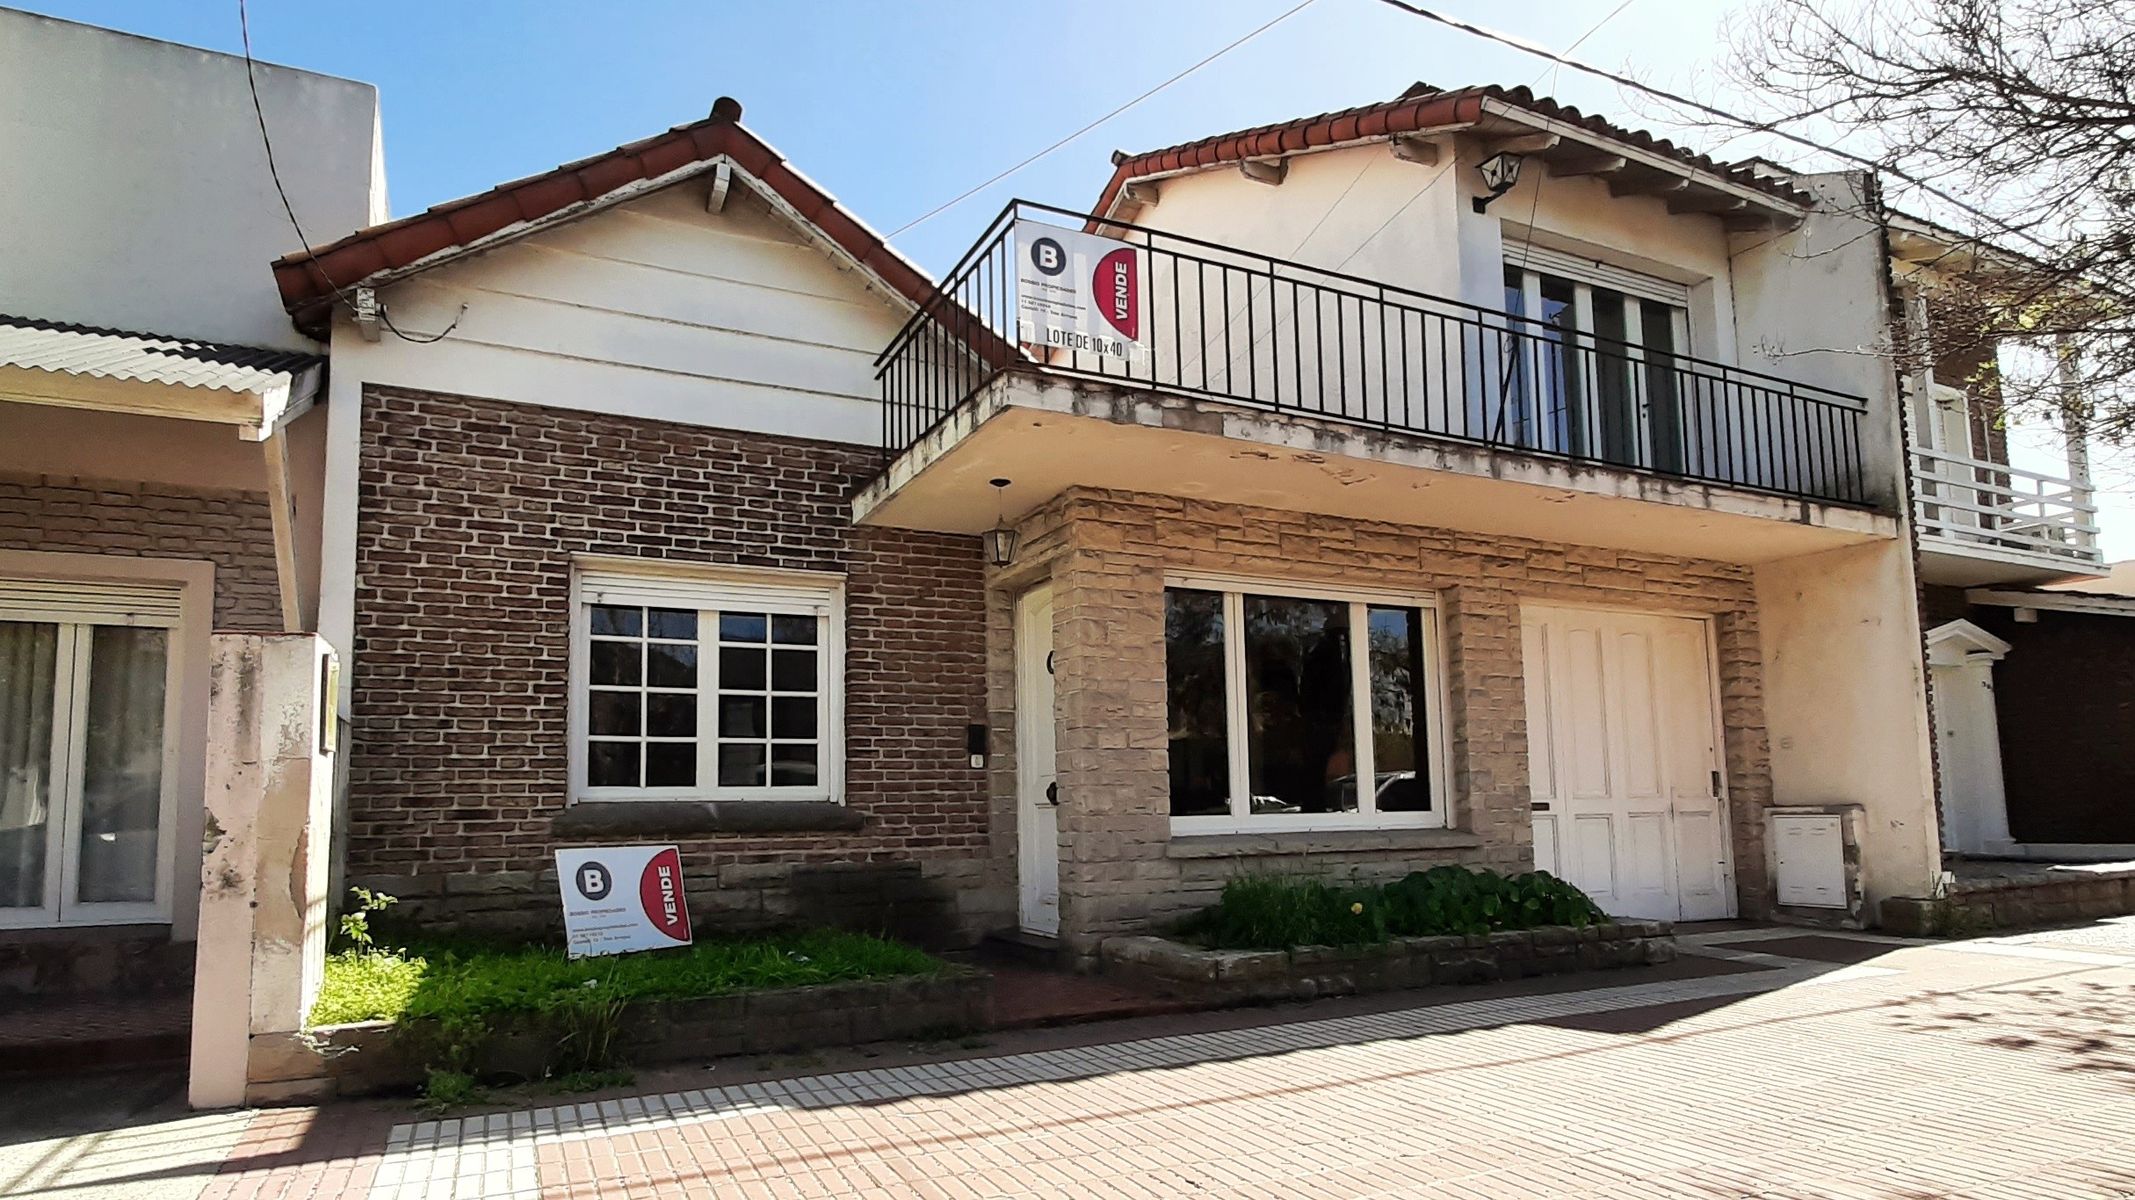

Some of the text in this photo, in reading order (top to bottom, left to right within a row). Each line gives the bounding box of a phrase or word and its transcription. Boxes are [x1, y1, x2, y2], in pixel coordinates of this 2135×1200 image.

[1039, 244, 1058, 269] B
[1115, 261, 1129, 320] VENDE
[1046, 327, 1123, 357] LOTE DE 10x40
[583, 869, 605, 893] B
[658, 865, 678, 926] VENDE
